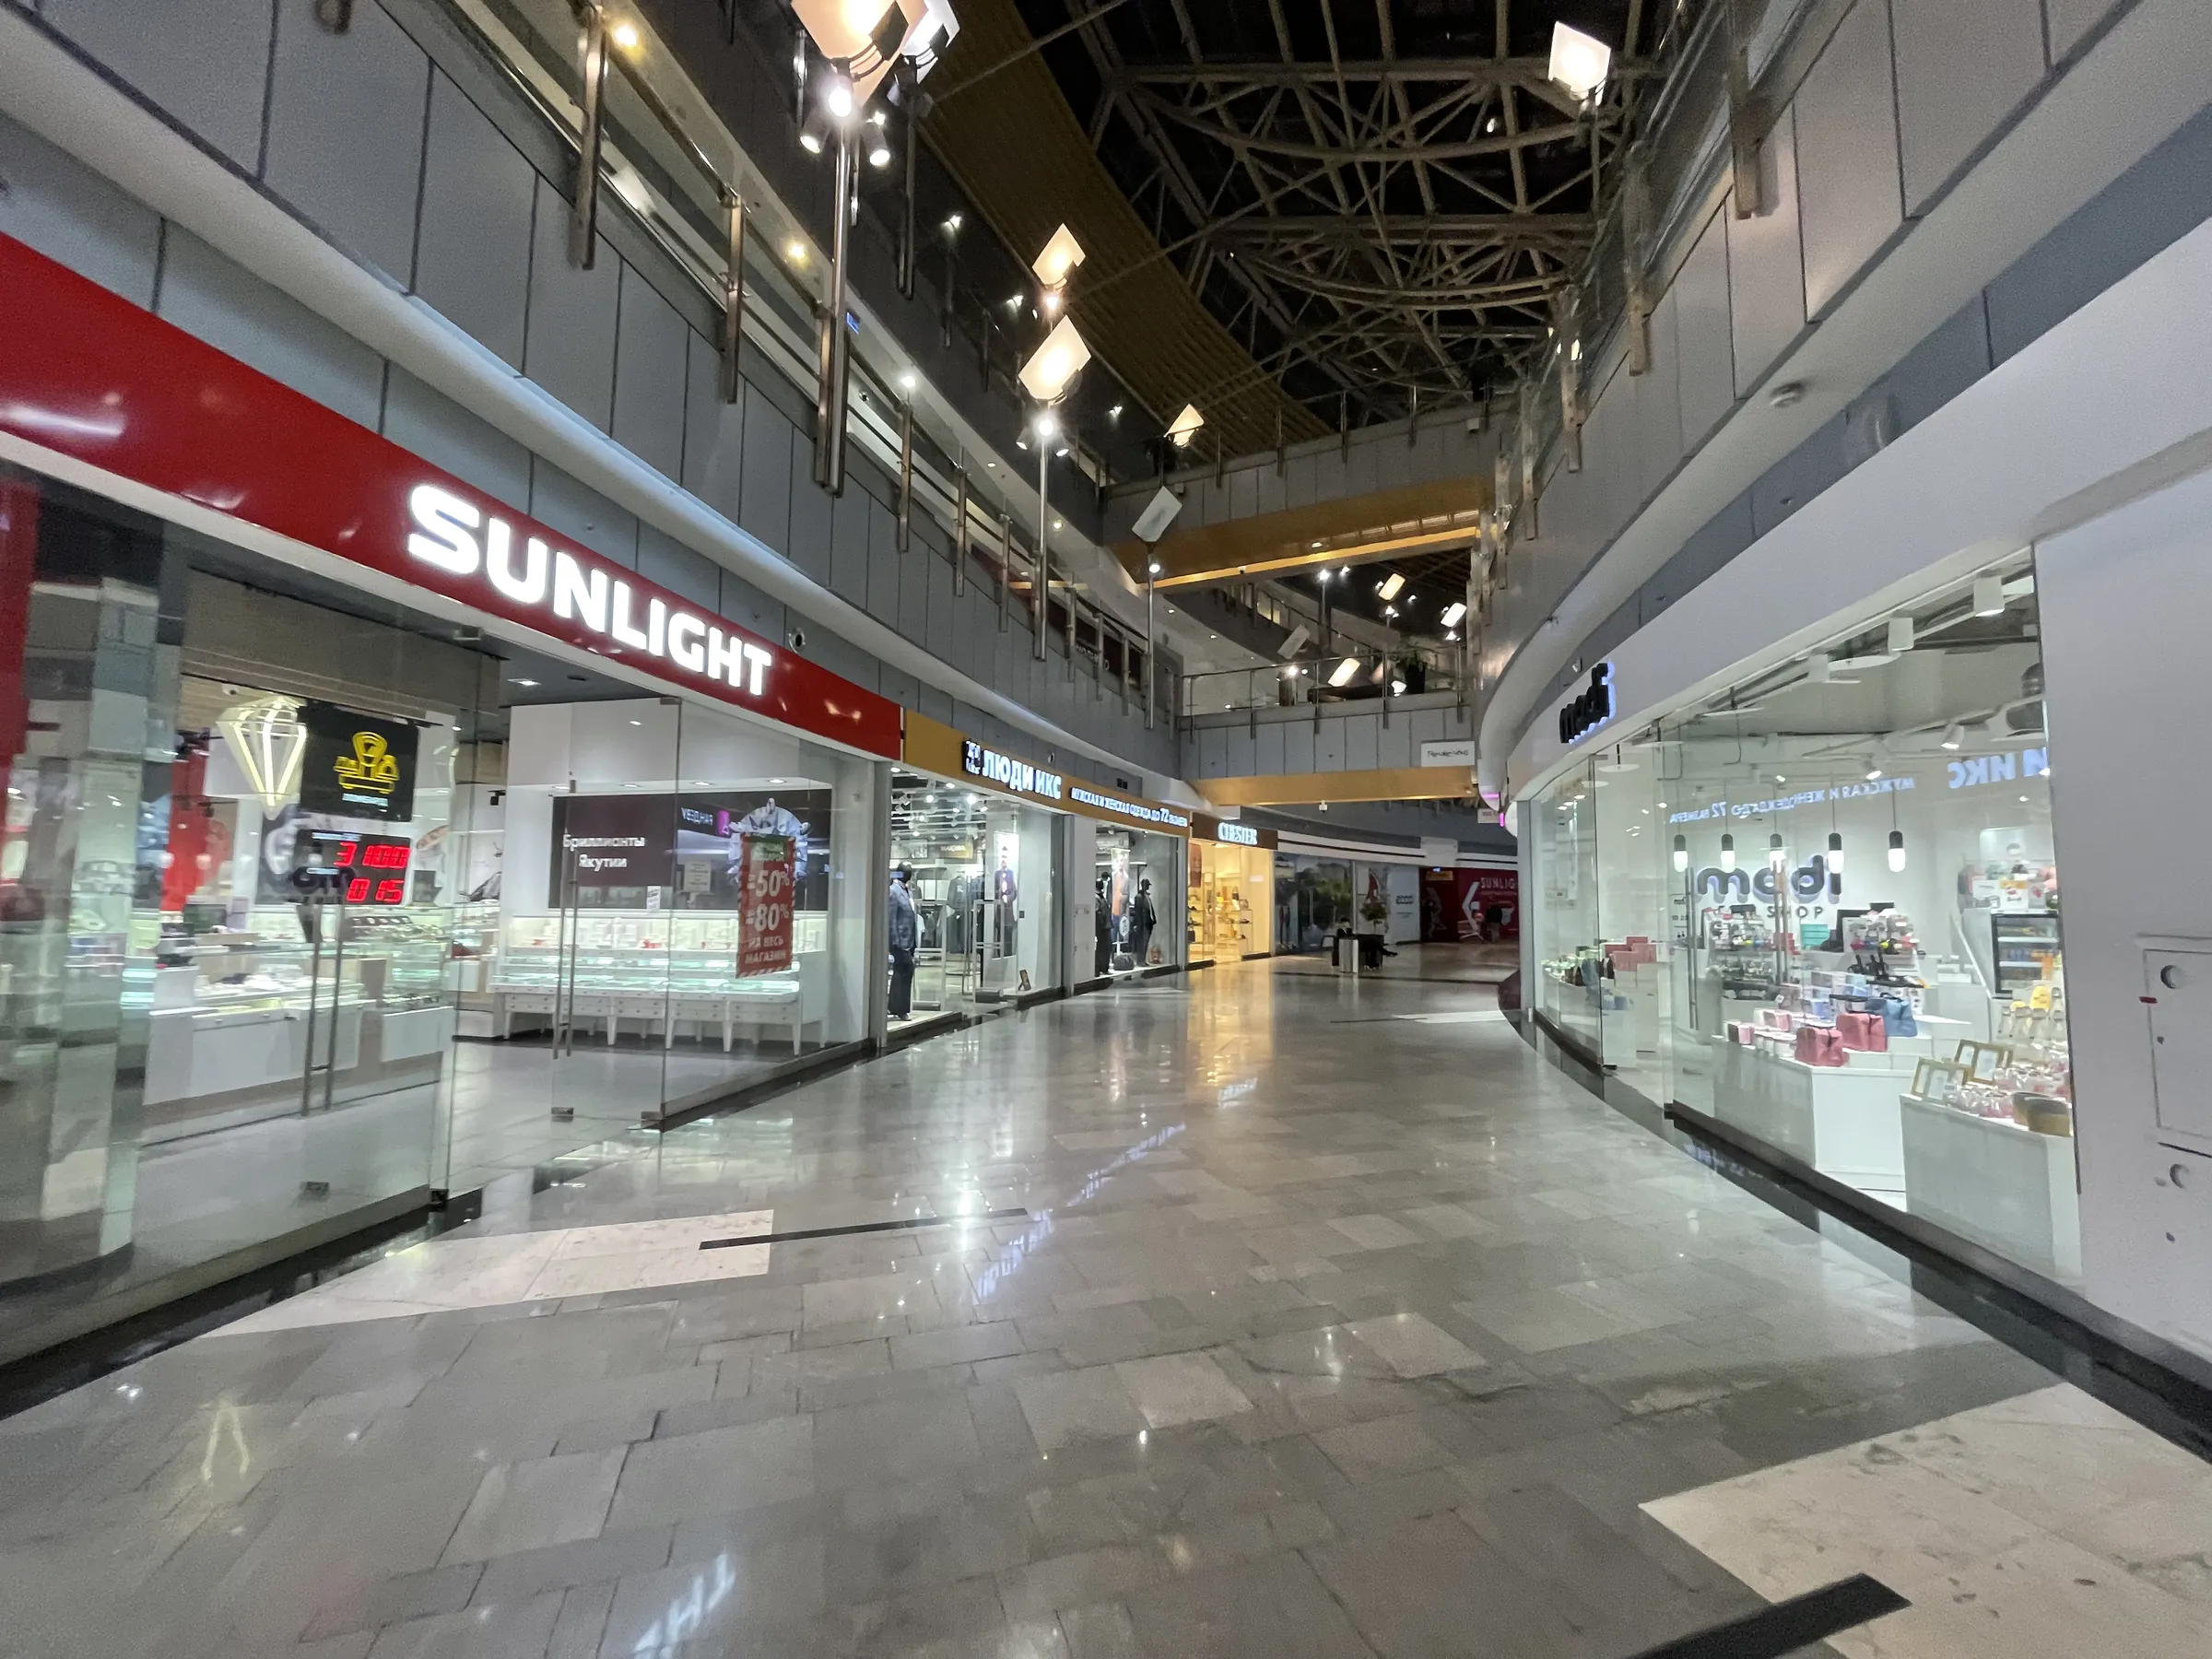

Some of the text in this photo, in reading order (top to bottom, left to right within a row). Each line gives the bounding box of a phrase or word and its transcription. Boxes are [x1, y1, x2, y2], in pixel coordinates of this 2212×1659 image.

[408, 484, 772, 697] SUNLIGHT
[982, 749, 1034, 792] ЛЮДИ
[1034, 769, 1062, 800] ИКС
[1218, 822, 1257, 845] CHESTER
[1697, 855, 1841, 897] modi
